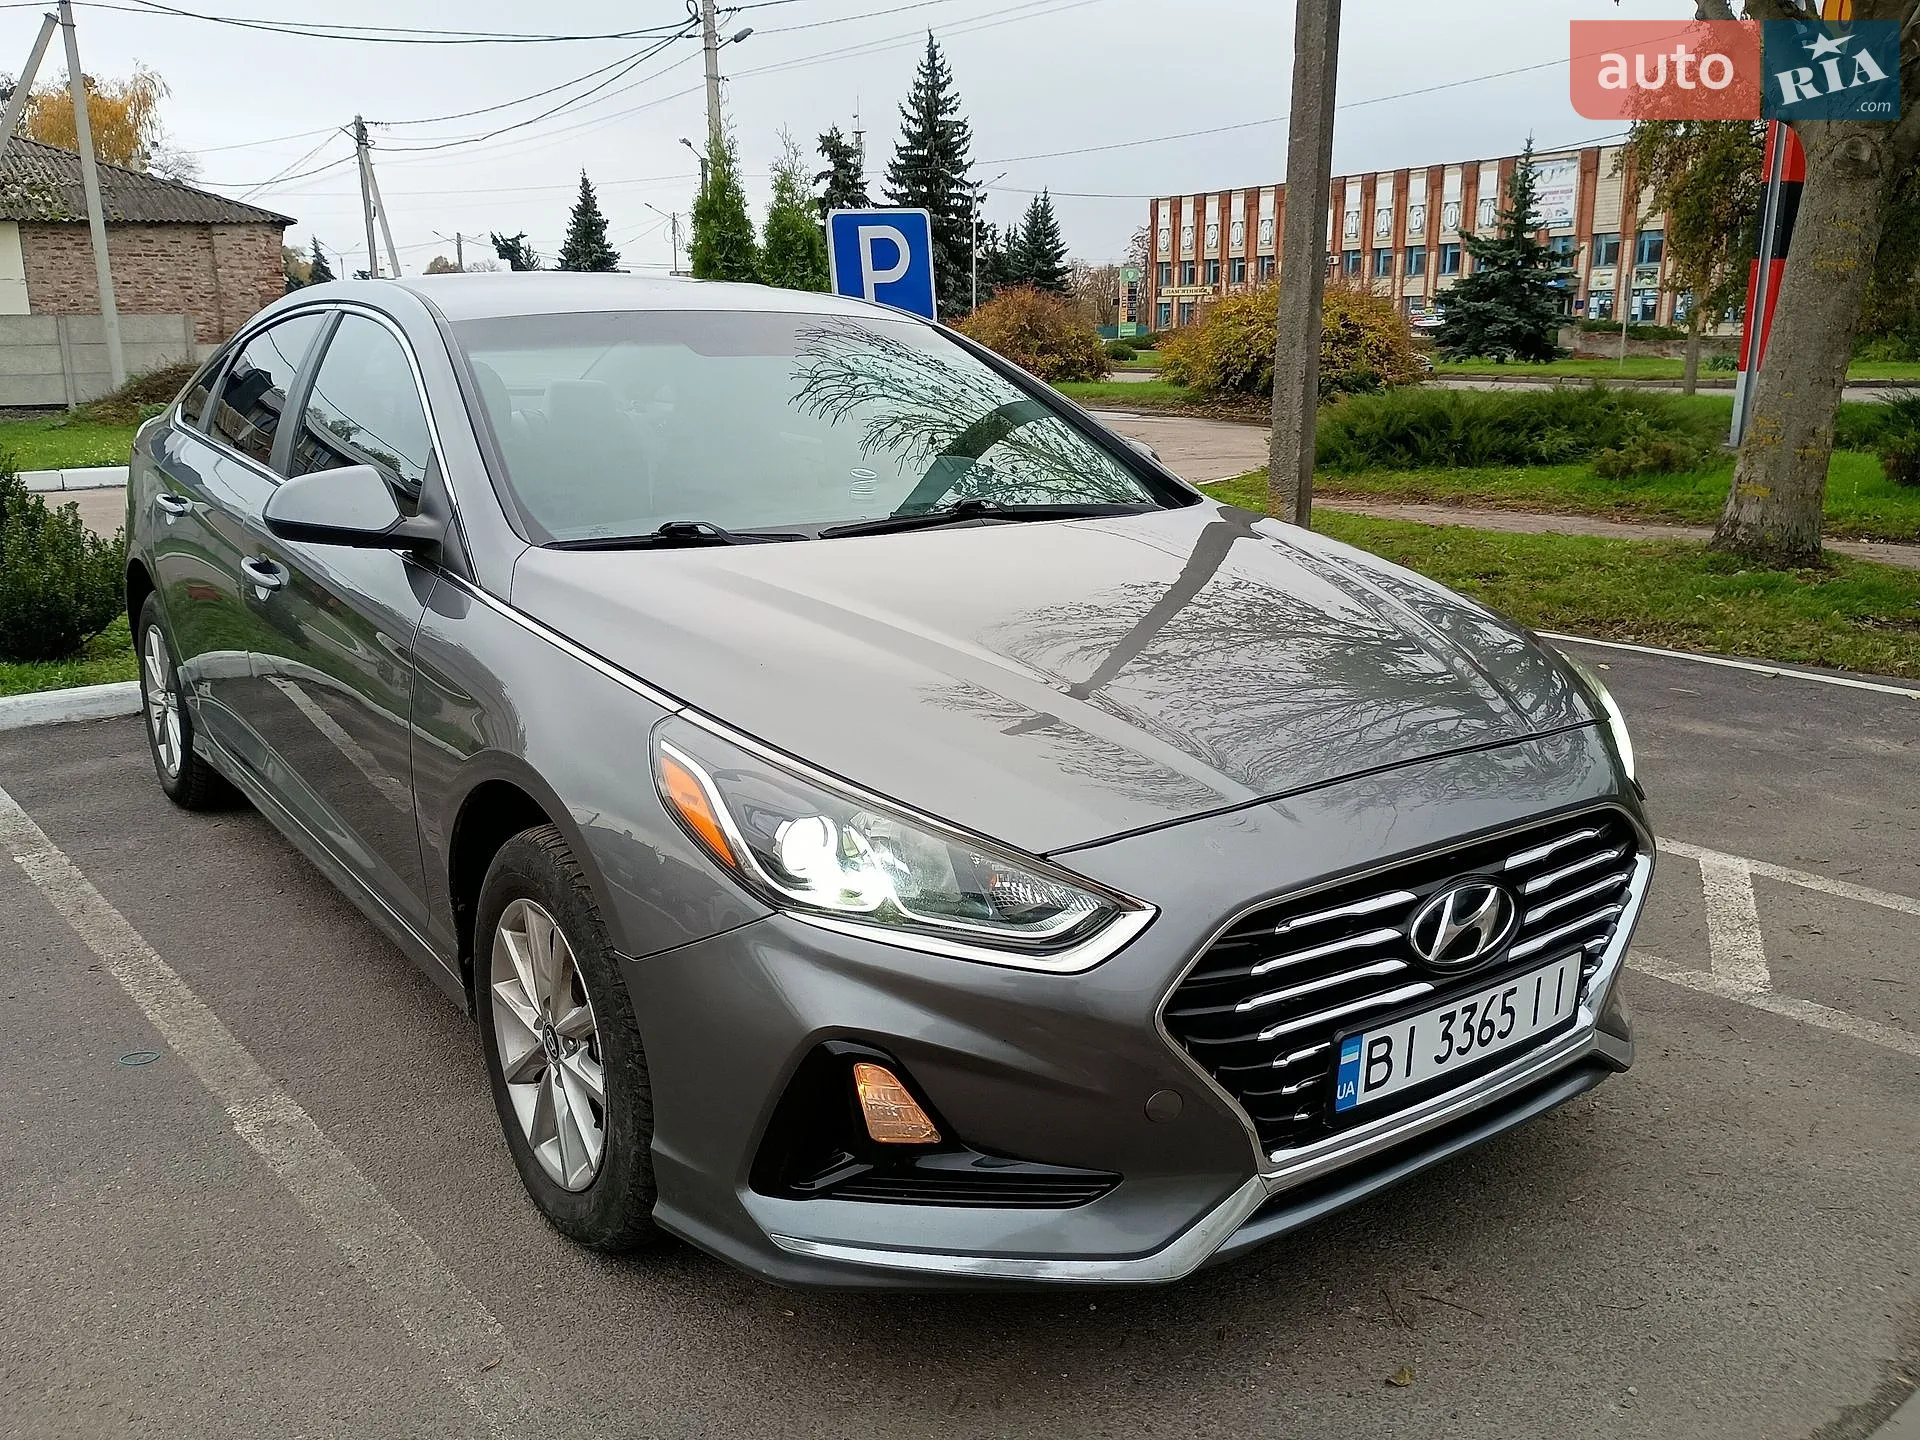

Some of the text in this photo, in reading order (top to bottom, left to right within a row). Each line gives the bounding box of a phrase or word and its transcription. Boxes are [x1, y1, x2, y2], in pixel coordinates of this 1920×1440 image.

[858, 225, 911, 302] P
[1433, 986, 1518, 1065] 3365
[1336, 1080, 1355, 1100] UA
